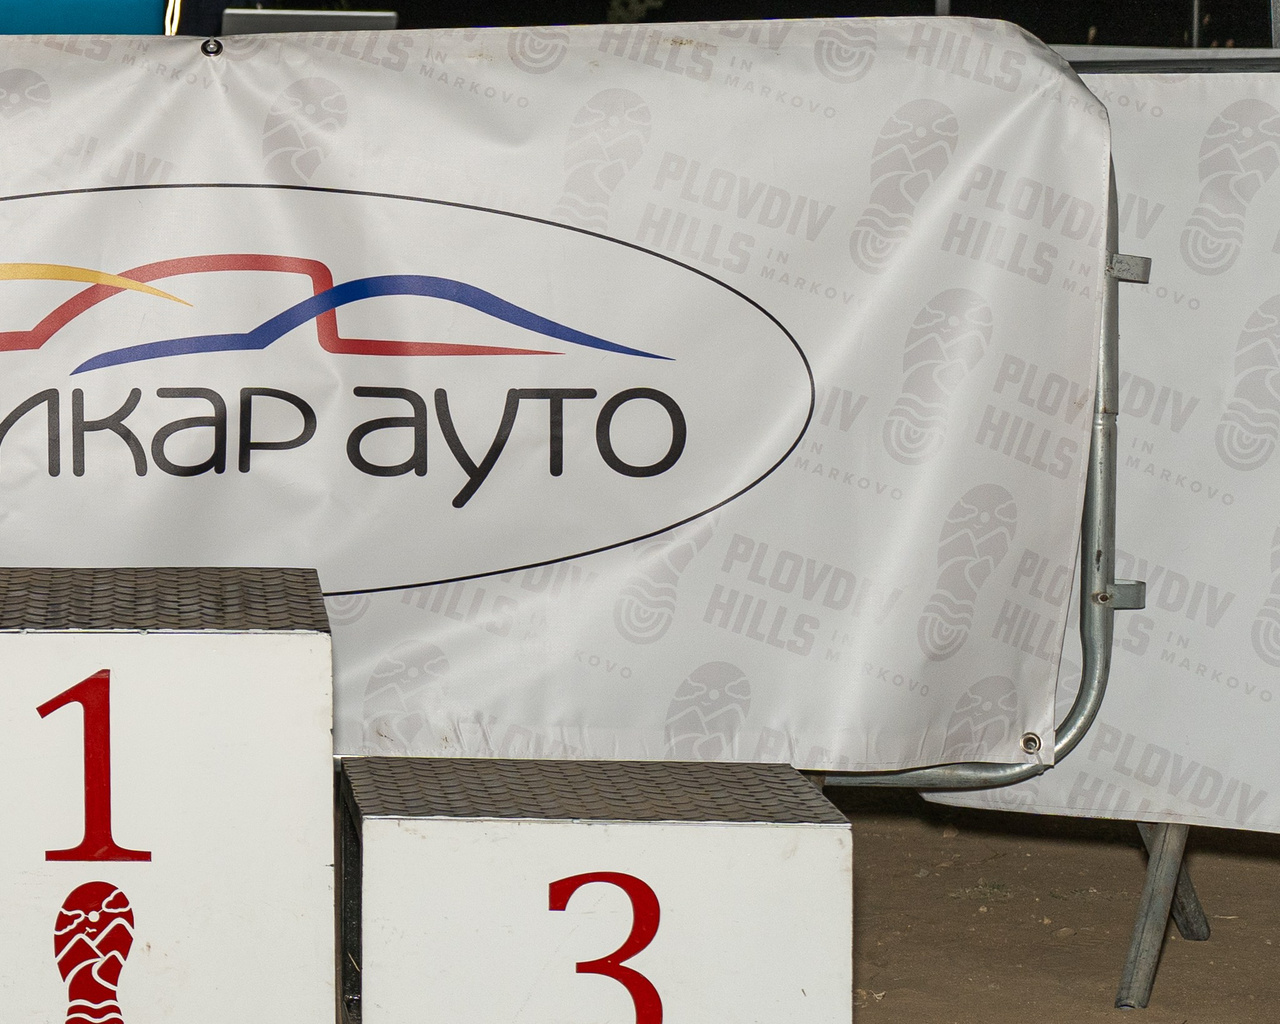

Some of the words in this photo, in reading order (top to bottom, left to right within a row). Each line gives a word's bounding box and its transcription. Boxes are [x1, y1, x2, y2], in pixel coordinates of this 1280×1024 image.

[425, 47, 448, 64] IN
[730, 57, 753, 72] IN
[906, 22, 1027, 94] HILLS
[419, 64, 530, 109] MARKOVO
[724, 75, 837, 120] MARKOVO
[652, 150, 837, 244] PLOVDIV
[635, 202, 756, 275] HILLS
[766, 247, 790, 264] IN
[940, 212, 1059, 286] HILLS
[760, 266, 856, 304] MARKOV
[1068, 260, 1091, 277] IN
[975, 404, 1079, 480] HILLS
[1131, 437, 1154, 455] IN
[794, 456, 903, 501] MARKOVO
[1125, 455, 1235, 507] MARKOVO
[702, 584, 820, 656] HILLS
[991, 598, 1057, 662] HILL
[1166, 631, 1191, 650] IN
[825, 648, 930, 697] MRKOVO
[1160, 649, 1273, 703] MARKOVO
[36, 669, 152, 862] 1
[1088, 720, 1269, 826] PLOVDIV
[548, 871, 664, 1024] 3
